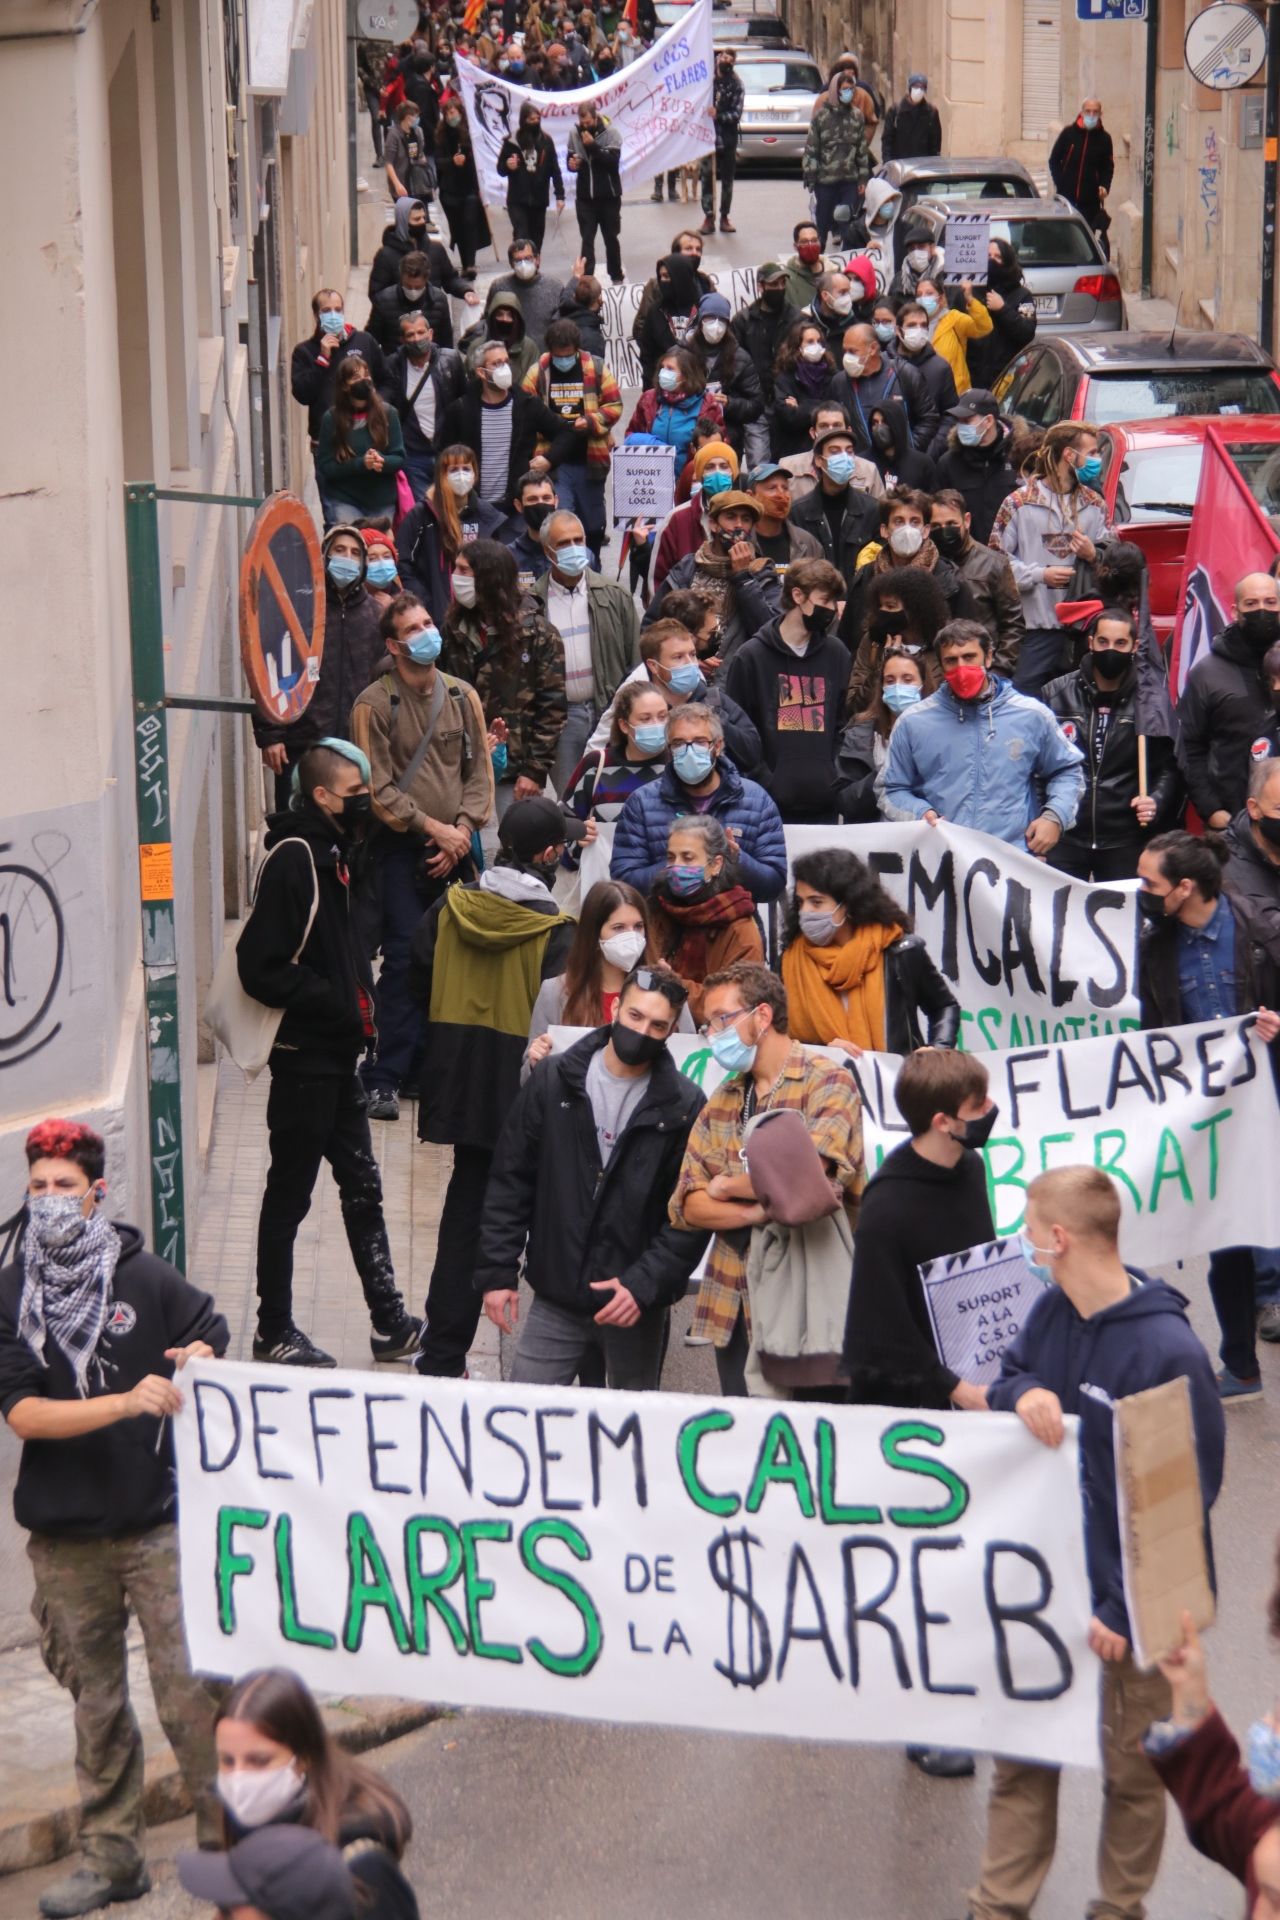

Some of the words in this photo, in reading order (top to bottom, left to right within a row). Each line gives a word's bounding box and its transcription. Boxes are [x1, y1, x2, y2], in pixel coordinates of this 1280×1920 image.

[664, 59, 708, 93] FLARES
[1005, 1012, 1260, 1129] FLARES
[957, 1283, 1022, 1314] SUPORT
[978, 1314, 990, 1328] A
[992, 1306, 1014, 1323] LA
[193, 1378, 648, 1510] DEFENSEM
[676, 1408, 970, 1529] CALS
[216, 1506, 604, 1677] FLARES
[624, 1553, 676, 1594] DE
[628, 1619, 693, 1657] LA
[707, 1526, 1074, 1702] $AREB
